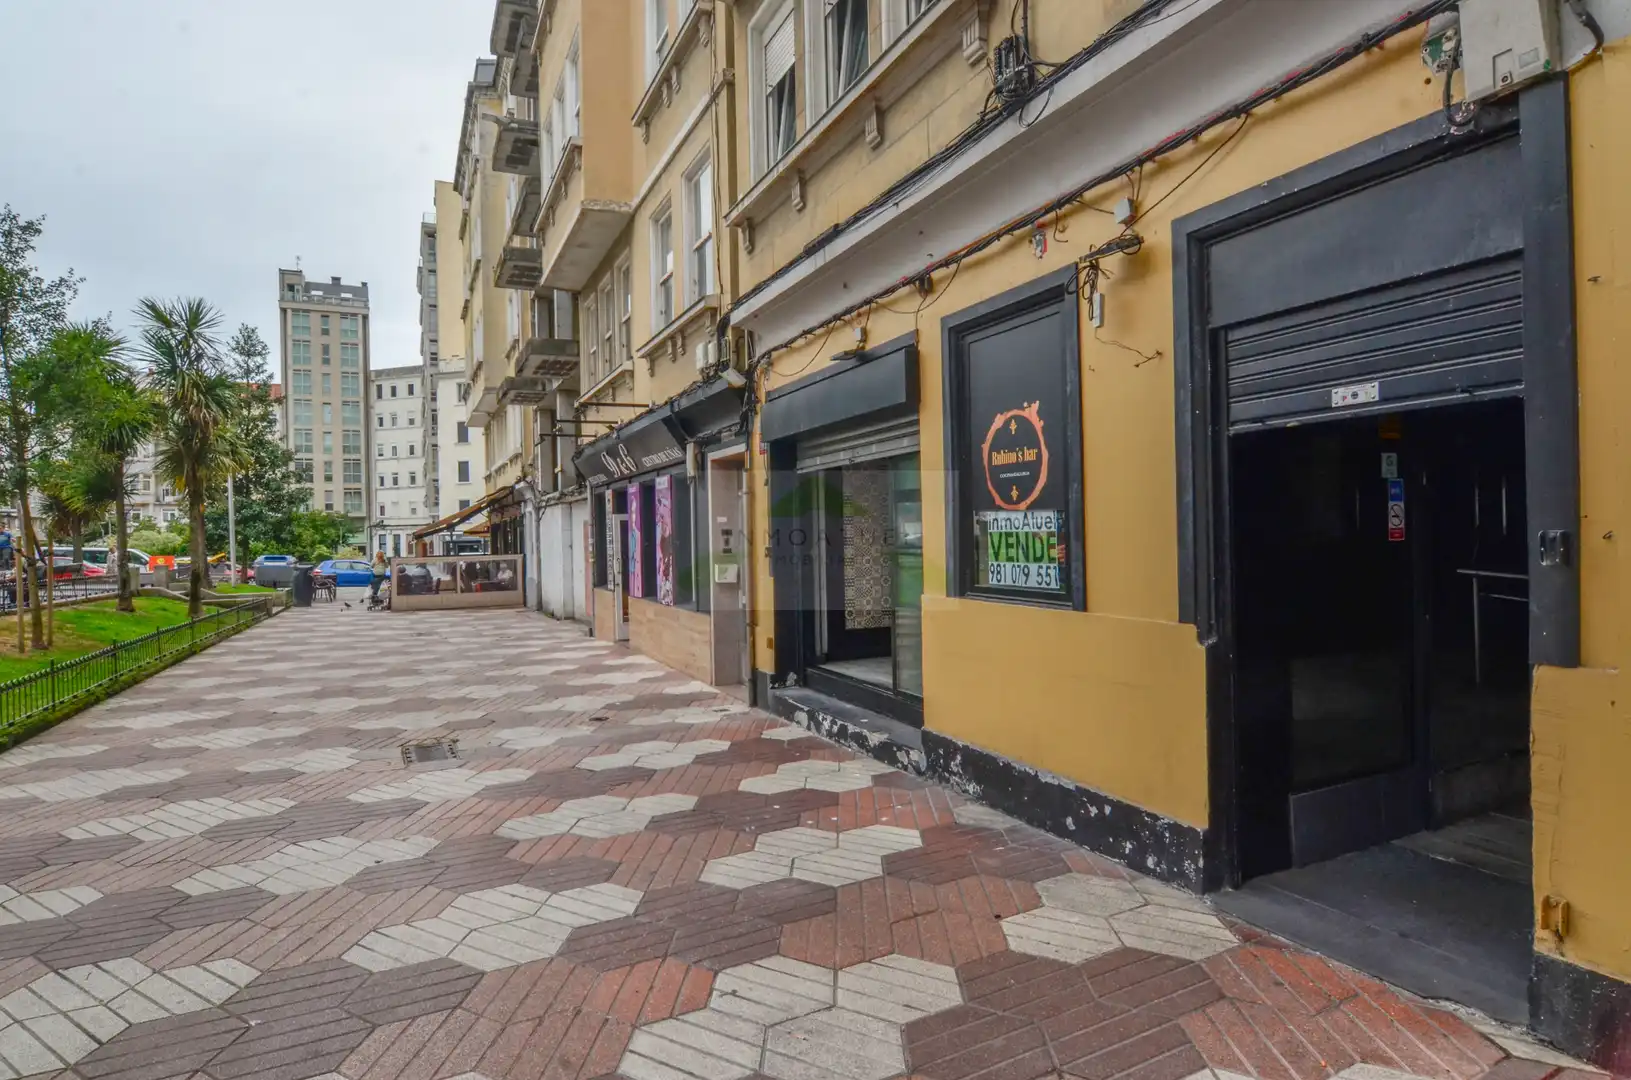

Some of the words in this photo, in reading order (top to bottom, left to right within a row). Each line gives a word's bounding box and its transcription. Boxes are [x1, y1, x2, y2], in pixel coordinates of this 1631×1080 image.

[1023, 446, 1038, 462] bar
[989, 531, 1057, 562] VENDE
[989, 562, 1007, 583] 981
[1011, 563, 1031, 586] 079
[1036, 564, 1060, 587] 551
